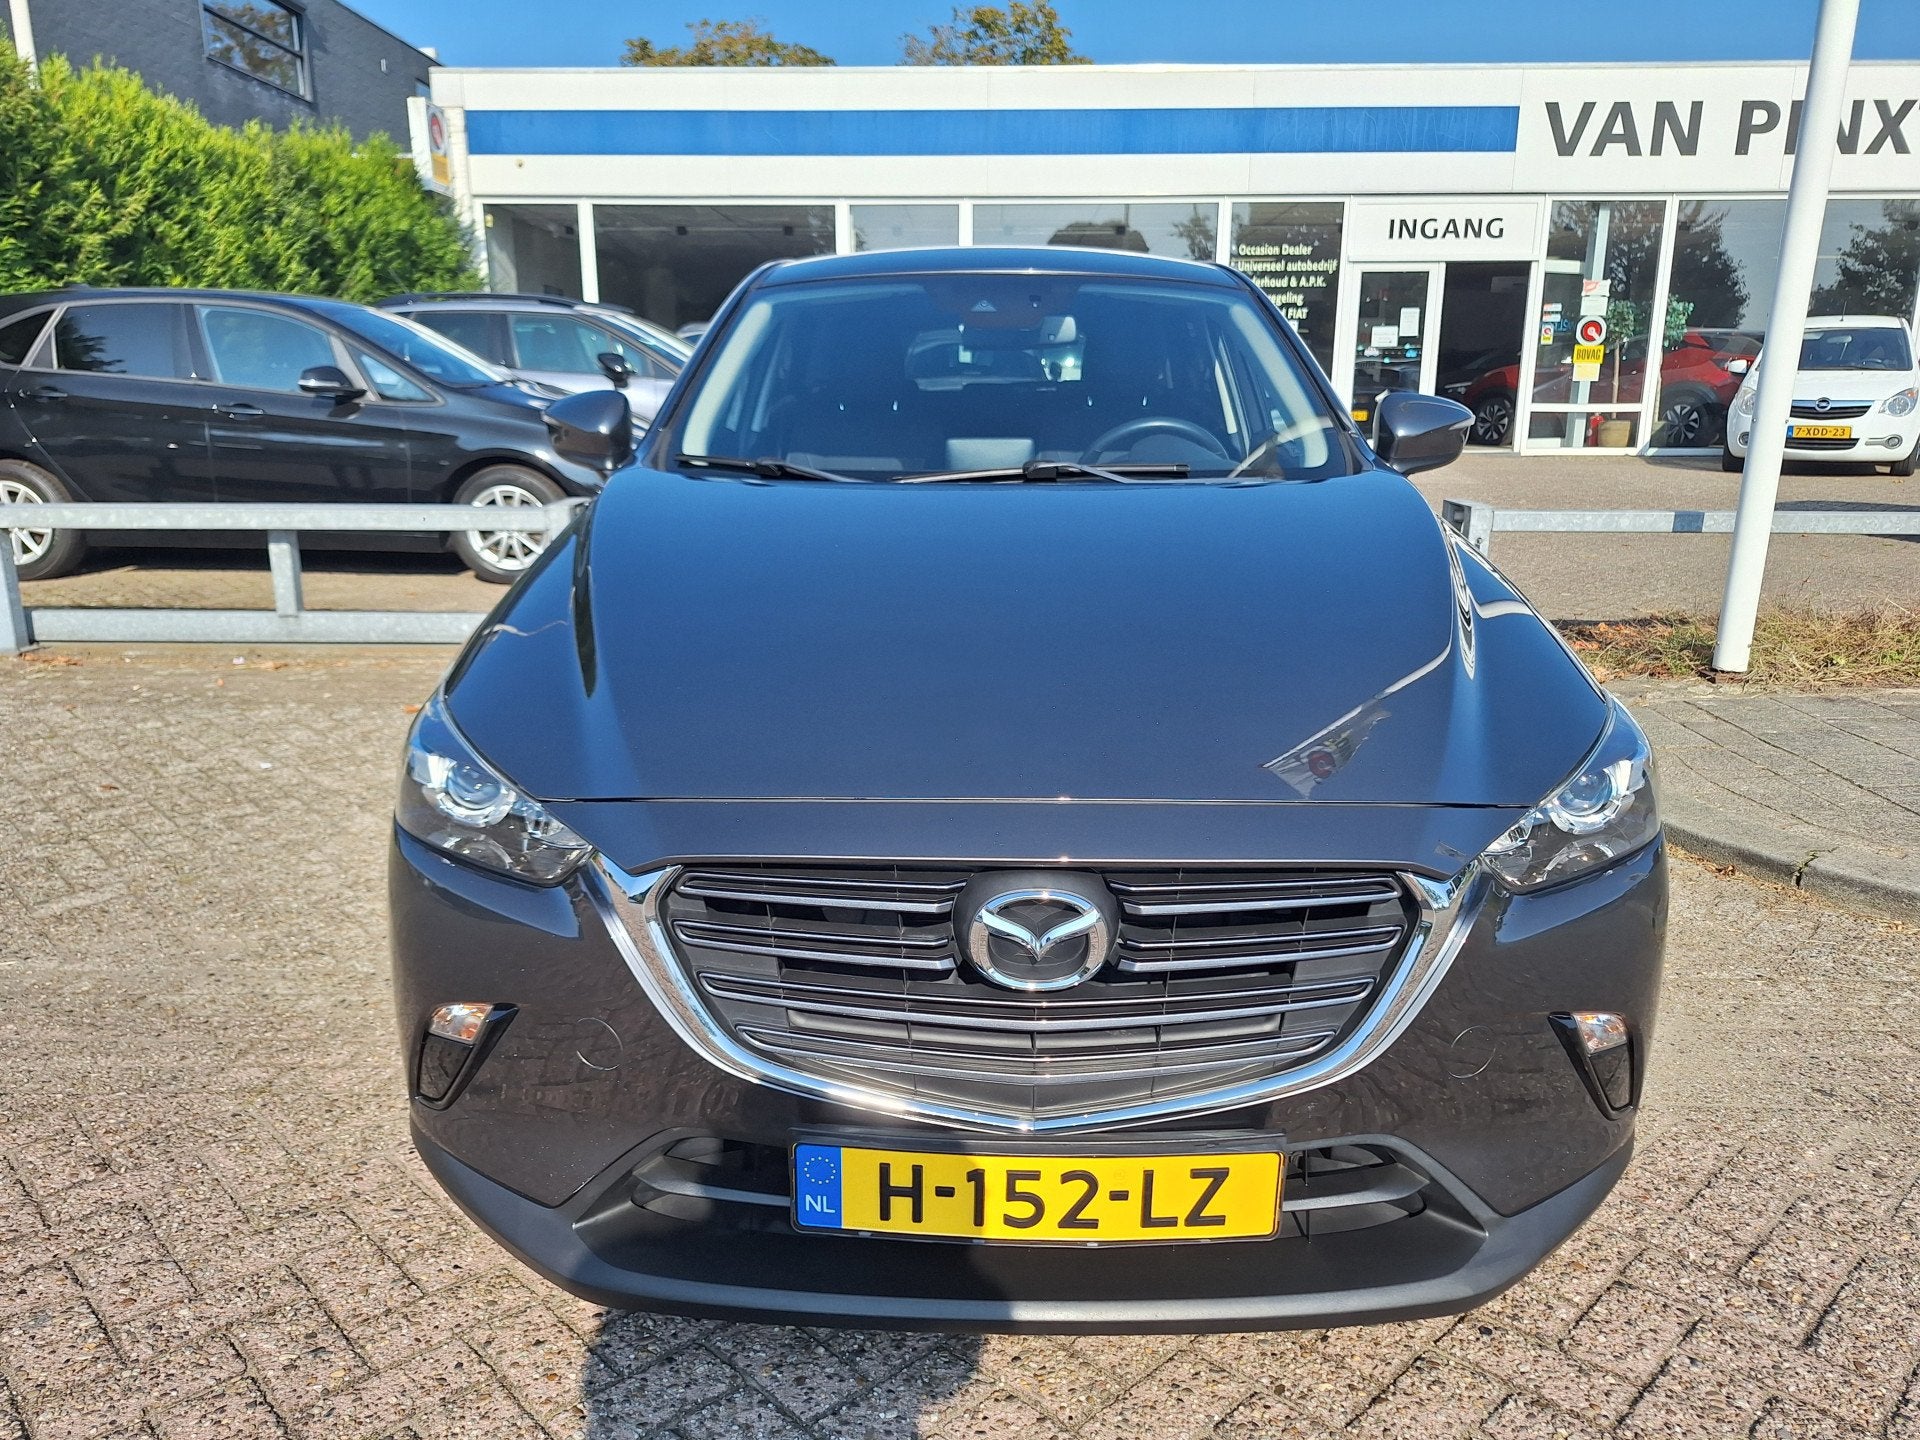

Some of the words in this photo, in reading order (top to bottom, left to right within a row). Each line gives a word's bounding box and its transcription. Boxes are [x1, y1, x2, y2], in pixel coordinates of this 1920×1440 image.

[1544, 100, 1704, 157] VAN
[1734, 99, 1920, 156] PINX
[1388, 217, 1505, 240] INGANG
[1238, 243, 1280, 256] Occasion
[1281, 243, 1313, 256] Dealer
[1238, 260, 1285, 272] Universeel
[1286, 259, 1338, 275] autobedrijf
[1289, 275, 1298, 288] &
[1299, 275, 1328, 288] A.P.K.
[1287, 307, 1309, 319] FIAT
[1576, 348, 1601, 361] BOVAG
[1795, 427, 1846, 437] 7-XDD-23
[805, 1194, 836, 1214] NL
[879, 1161, 1230, 1230] H-152-LZ
